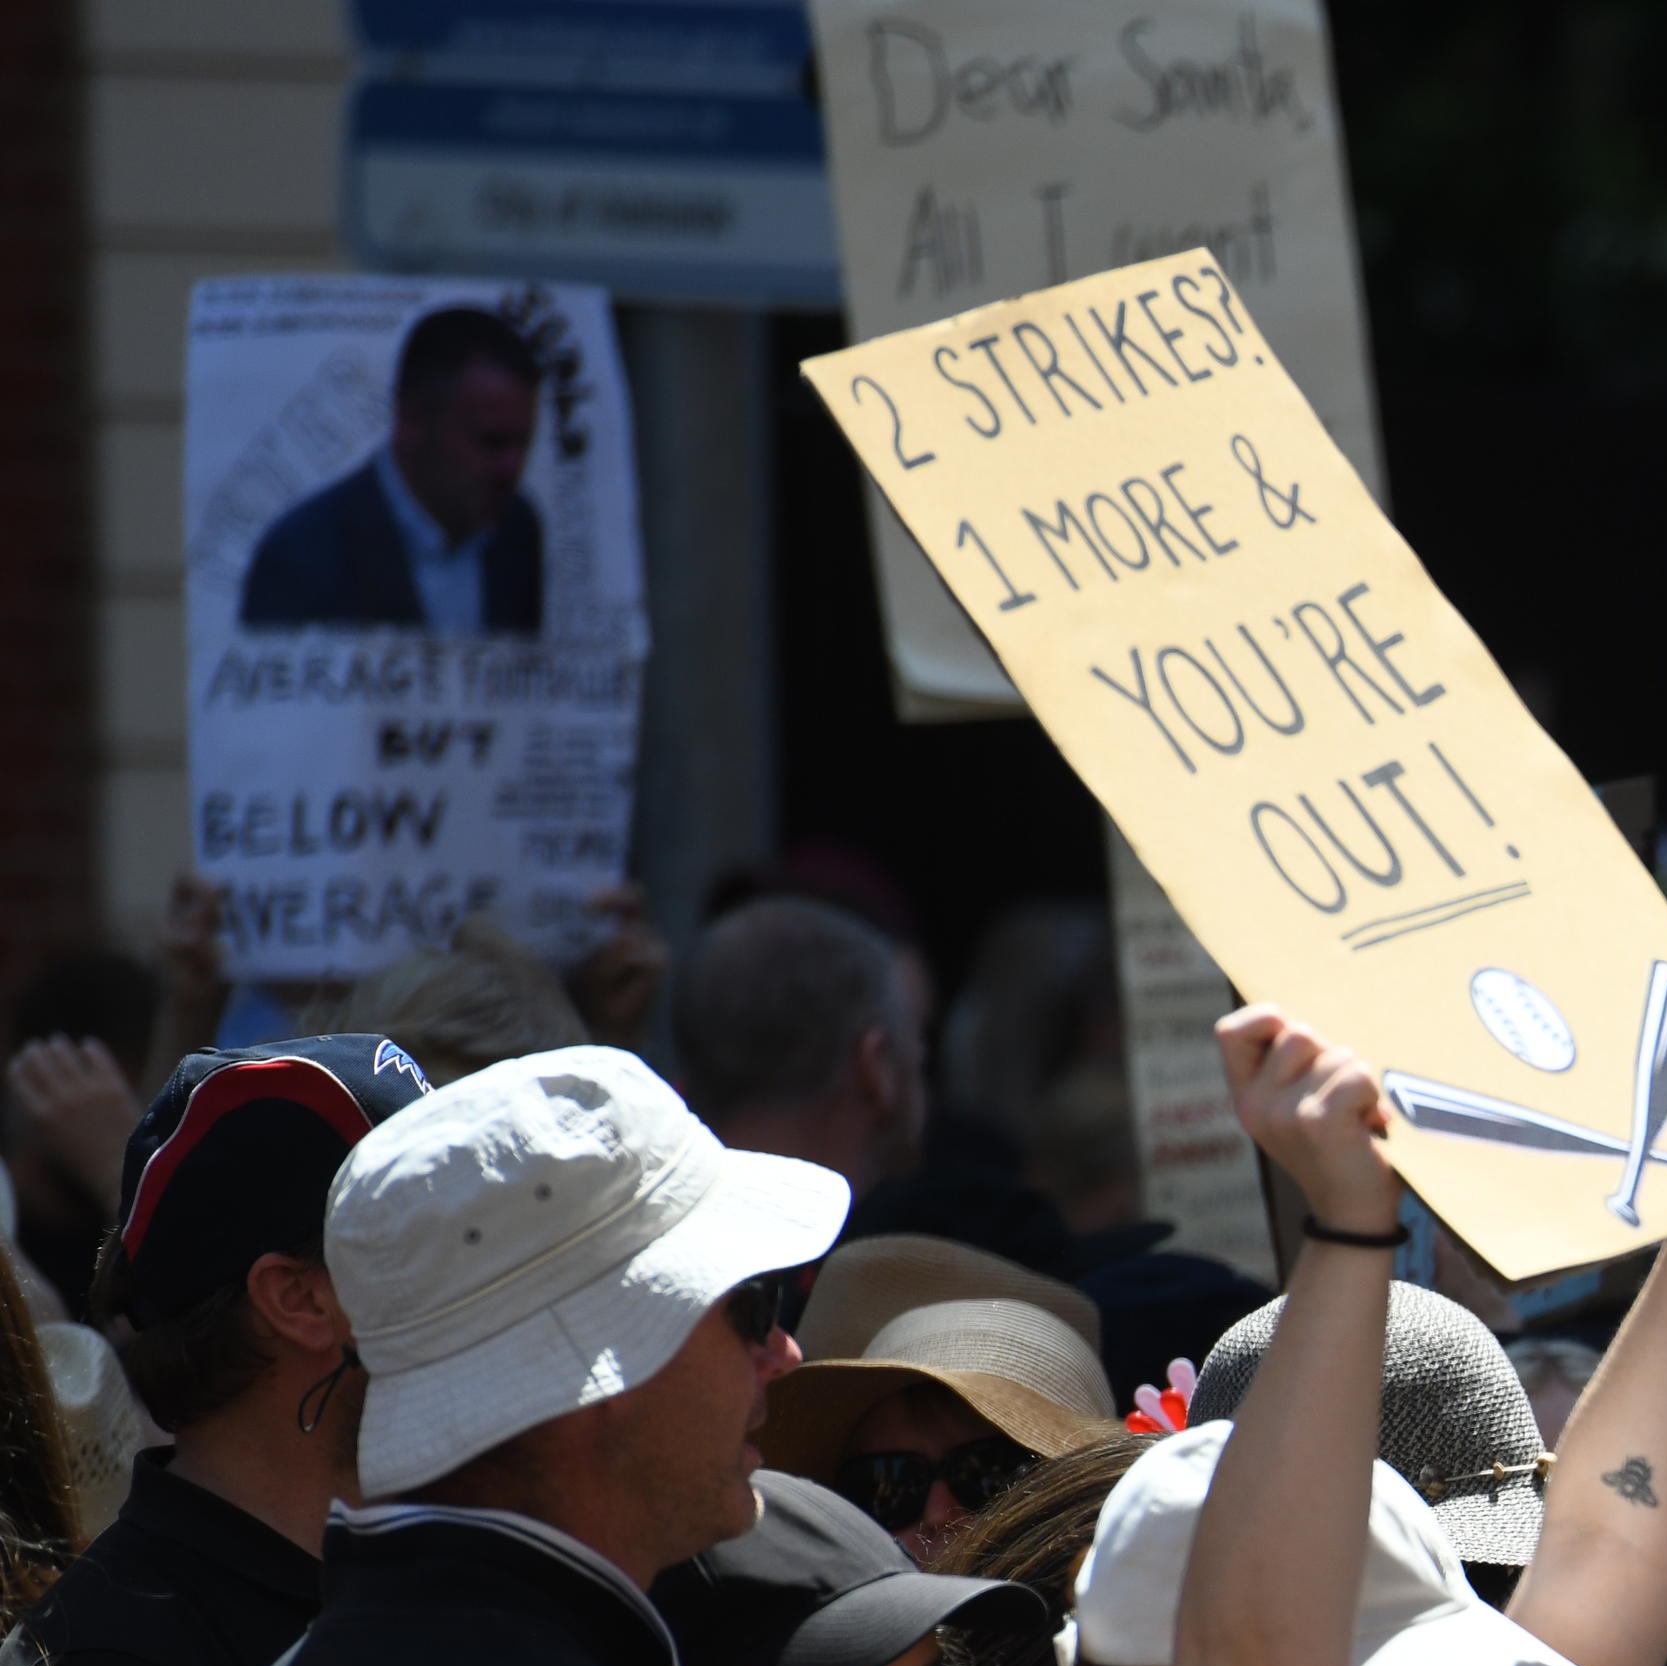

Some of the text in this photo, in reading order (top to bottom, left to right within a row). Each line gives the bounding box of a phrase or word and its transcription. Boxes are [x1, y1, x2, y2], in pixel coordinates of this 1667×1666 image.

[867, 14, 1078, 150] Dear
[896, 182, 985, 298] All
[852, 267, 1264, 470] 2 STRIKES?
[957, 433, 1317, 612] 1 MORE &
[378, 716, 500, 770] BUT
[1090, 582, 1446, 774] YOU'RE
[199, 788, 450, 858] BELOW
[1250, 742, 1521, 914] OUT!
